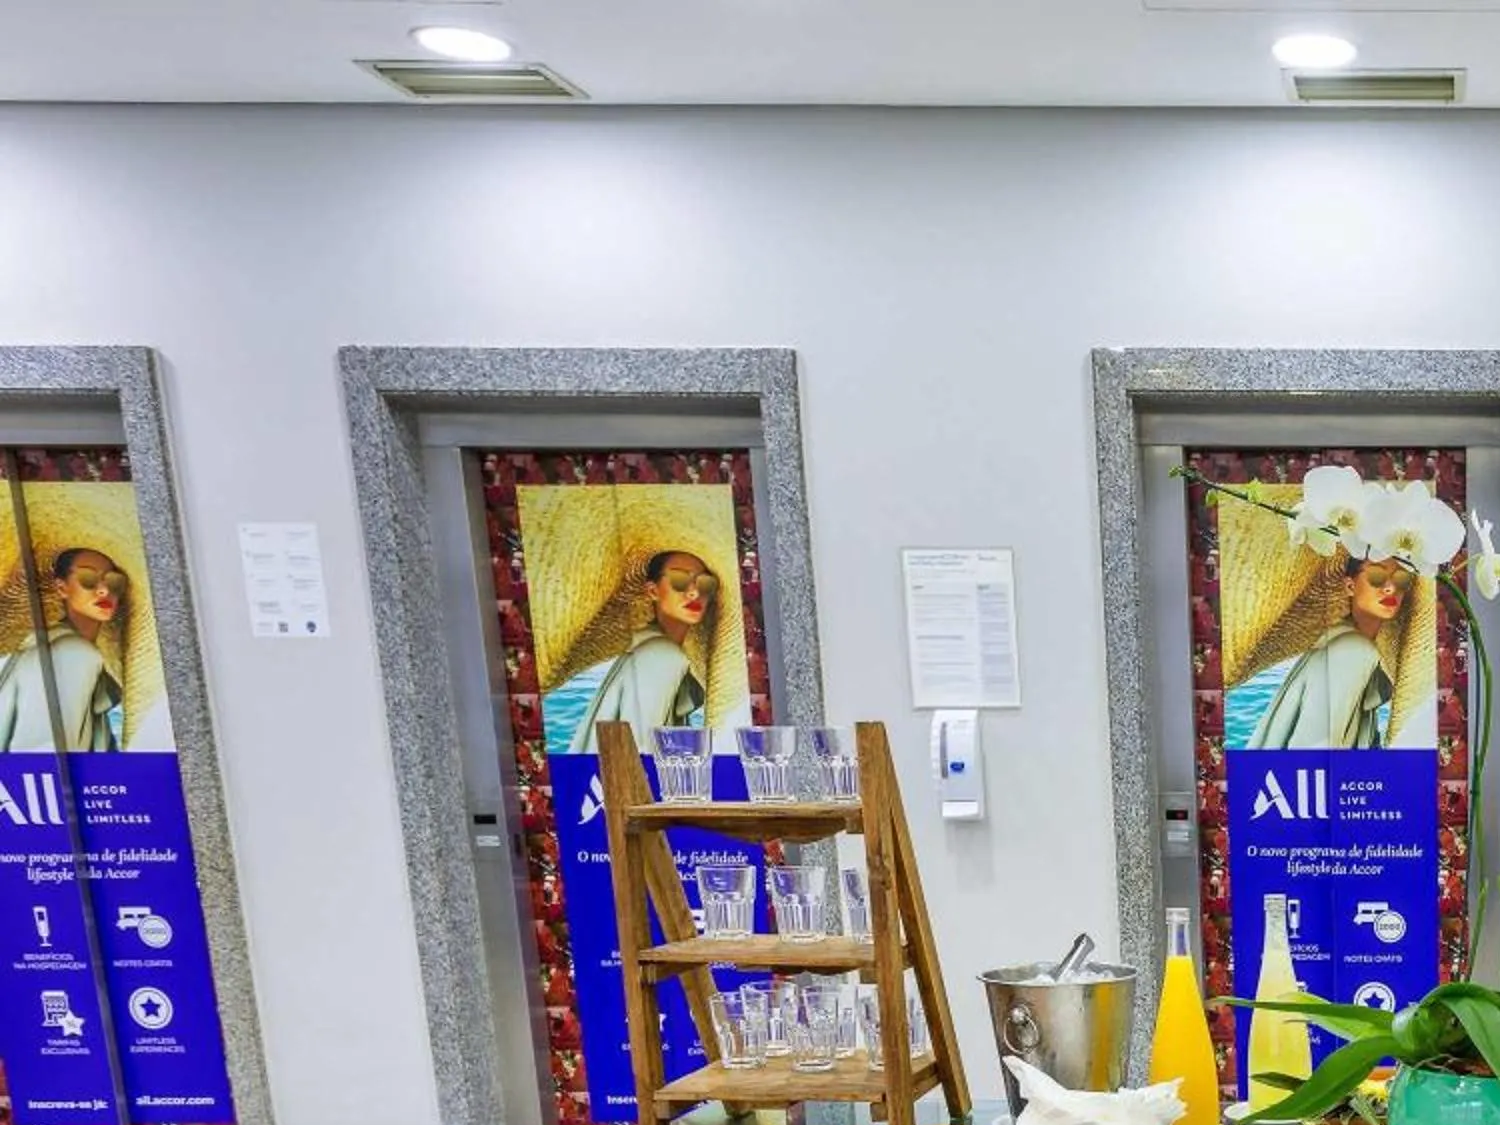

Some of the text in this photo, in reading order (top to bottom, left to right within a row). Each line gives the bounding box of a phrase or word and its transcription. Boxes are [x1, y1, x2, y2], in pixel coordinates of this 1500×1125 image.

[83, 785, 127, 795] ACCOR
[1340, 782, 1383, 791] ACCOR
[1250, 769, 1329, 820] All
[1340, 797, 1367, 805] LIVE
[84, 799, 112, 809] LIVE
[87, 814, 152, 824] LIMITLESS
[1340, 812, 1402, 820] LIMITLESS
[101, 848, 116, 862] de
[118, 848, 178, 865] fidelidade
[577, 851, 589, 862] O
[591, 853, 611, 863] nov
[688, 850, 749, 867] fidelidade
[1247, 843, 1423, 861] O novo programa de fidelidade
[27, 867, 75, 884] lifestyle
[103, 866, 141, 880] Accor
[1287, 860, 1384, 877] lifestyle da Accor
